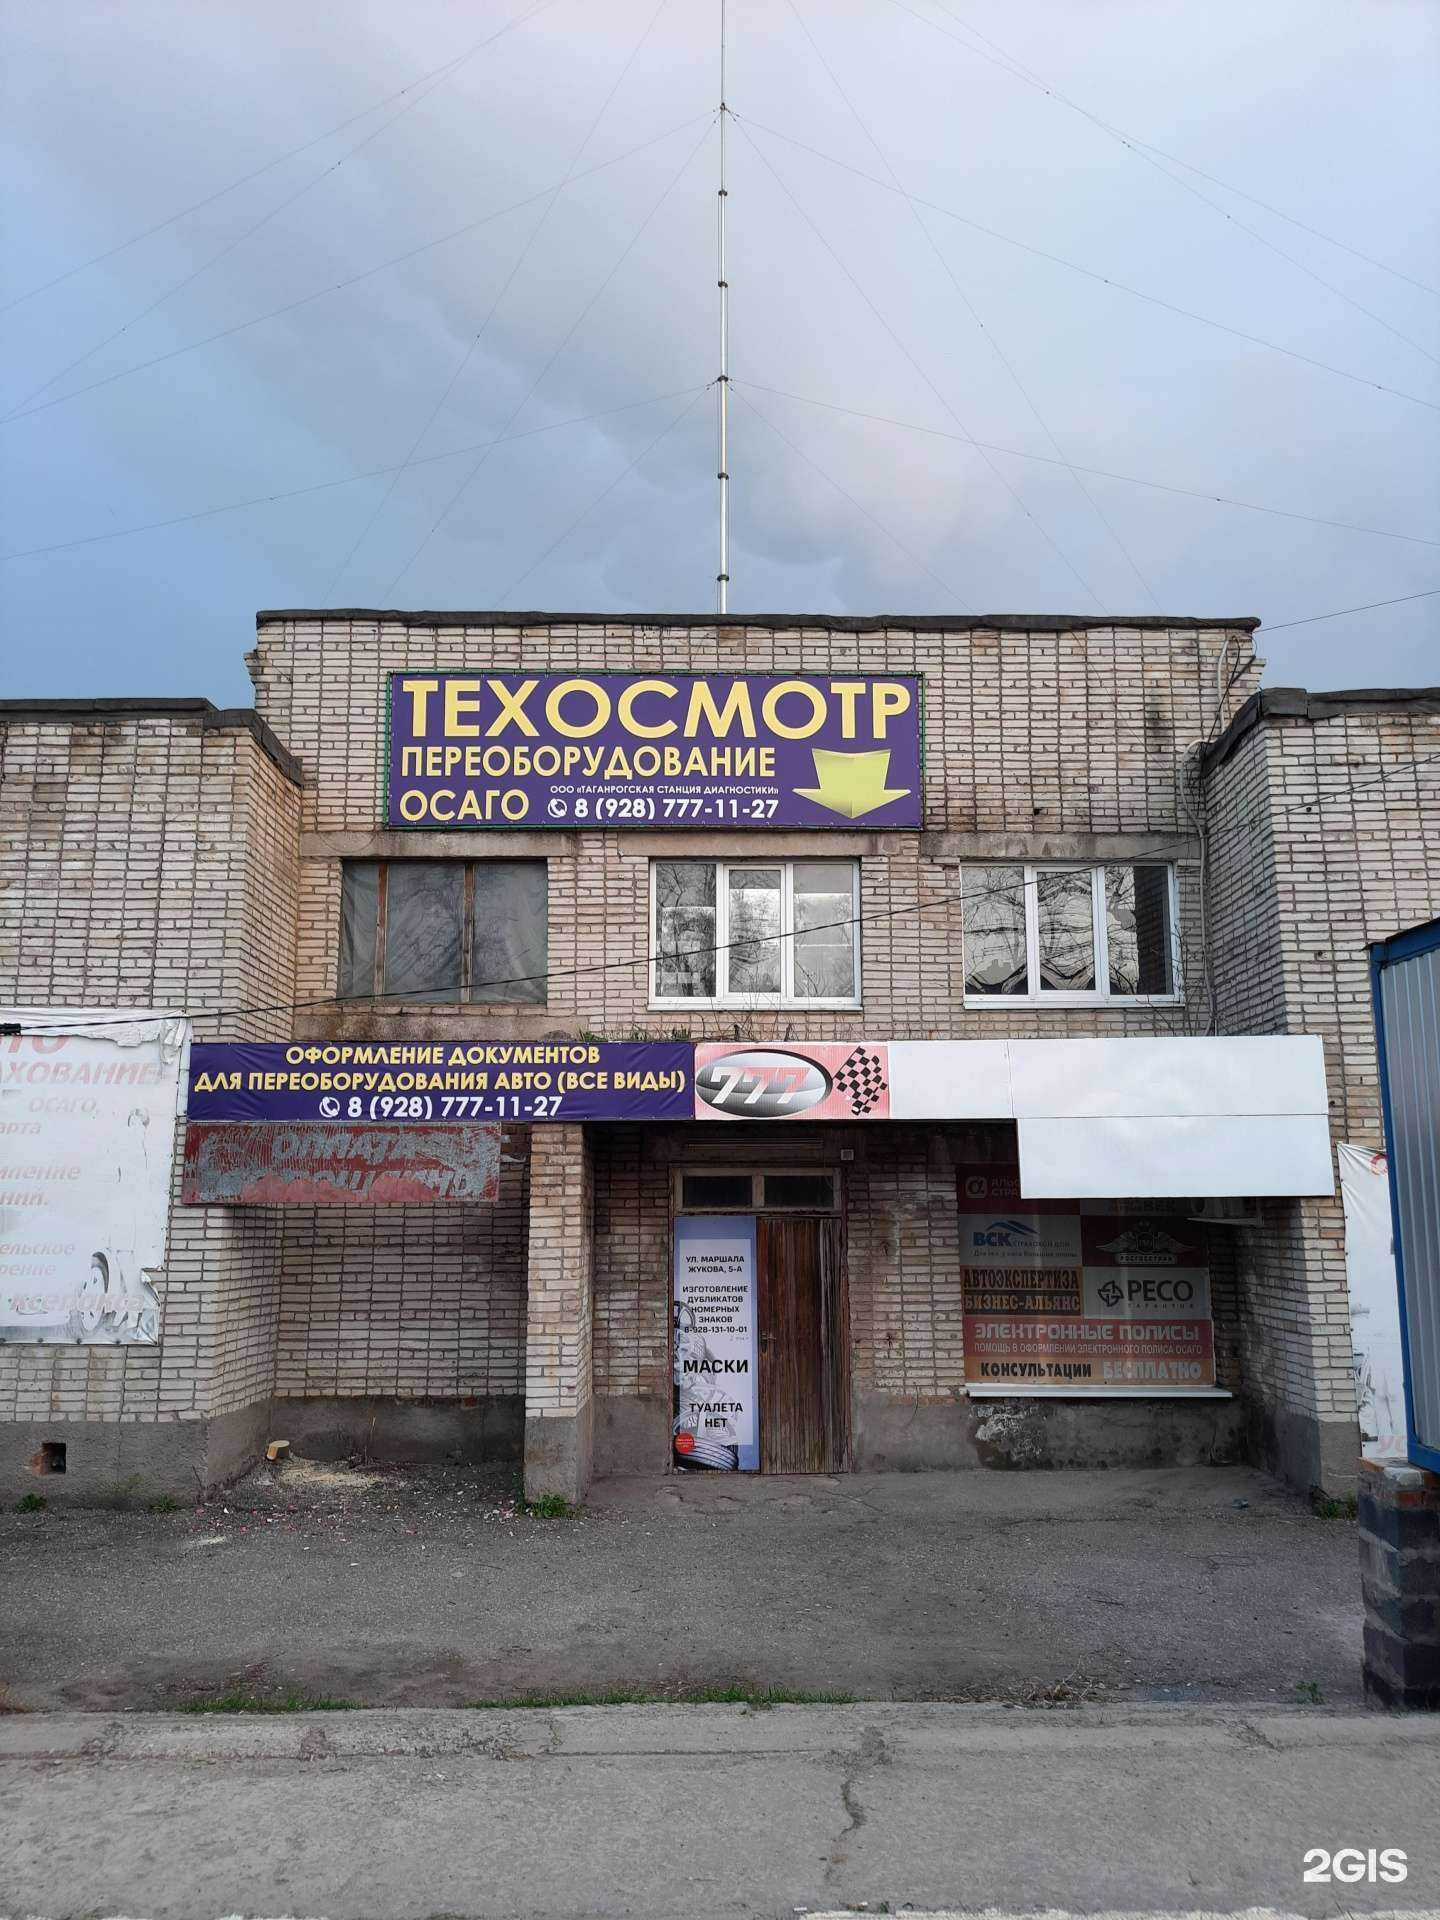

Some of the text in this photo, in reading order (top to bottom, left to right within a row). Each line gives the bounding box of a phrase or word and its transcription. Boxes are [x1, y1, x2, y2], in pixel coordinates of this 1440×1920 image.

[402, 679, 911, 739] ТЕХОСМОТР
[401, 746, 775, 780] ПЕРЕОБОРУДОВАНИЕ
[550, 785, 779, 795] ООО «ТАГАНРОГСКАЯ СТАНЦИЯ ДИАГНОСТИКИ»
[399, 789, 529, 821] ОСАГО
[574, 798, 779, 820] 8 (928) 777-11-27
[285, 1046, 600, 1066] ОФОРМЛЕНИЕ ДОКУМЕНТОВ
[194, 1072, 686, 1093] ДЛЯ ПЕРЕОБОРУДОВАНИЯ АВТО (ВСЕ ВИДЫ)
[710, 1066, 809, 1104] 777
[347, 1097, 562, 1120] 8 (928) 777-11-27
[973, 1232, 1013, 1247] ВСК
[688, 1266, 727, 1274] ЖУКОВА,
[964, 1269, 1078, 1289] АВТОЭКСПЕРТИЗА
[682, 1285, 748, 1293] ИЗГОТОВЛЕНИЕ
[1127, 1279, 1194, 1301] РЕСО
[687, 1295, 744, 1304] ДУБЛИКАТОВ
[964, 1295, 1080, 1312] БИЗНЕС-АЛЬЯНС
[698, 1315, 733, 1323] ЗНАКОВ
[975, 1324, 1114, 1340] ЭЛЕКТРОННЫЕ
[683, 1359, 749, 1373] МАСКИ
[981, 1361, 1201, 1381] КОНСУЛЬТАЦИИ БЕСПЛАТНО
[689, 1402, 744, 1413] ТУАЛЕТА
[704, 1418, 728, 1428] НЕТ
